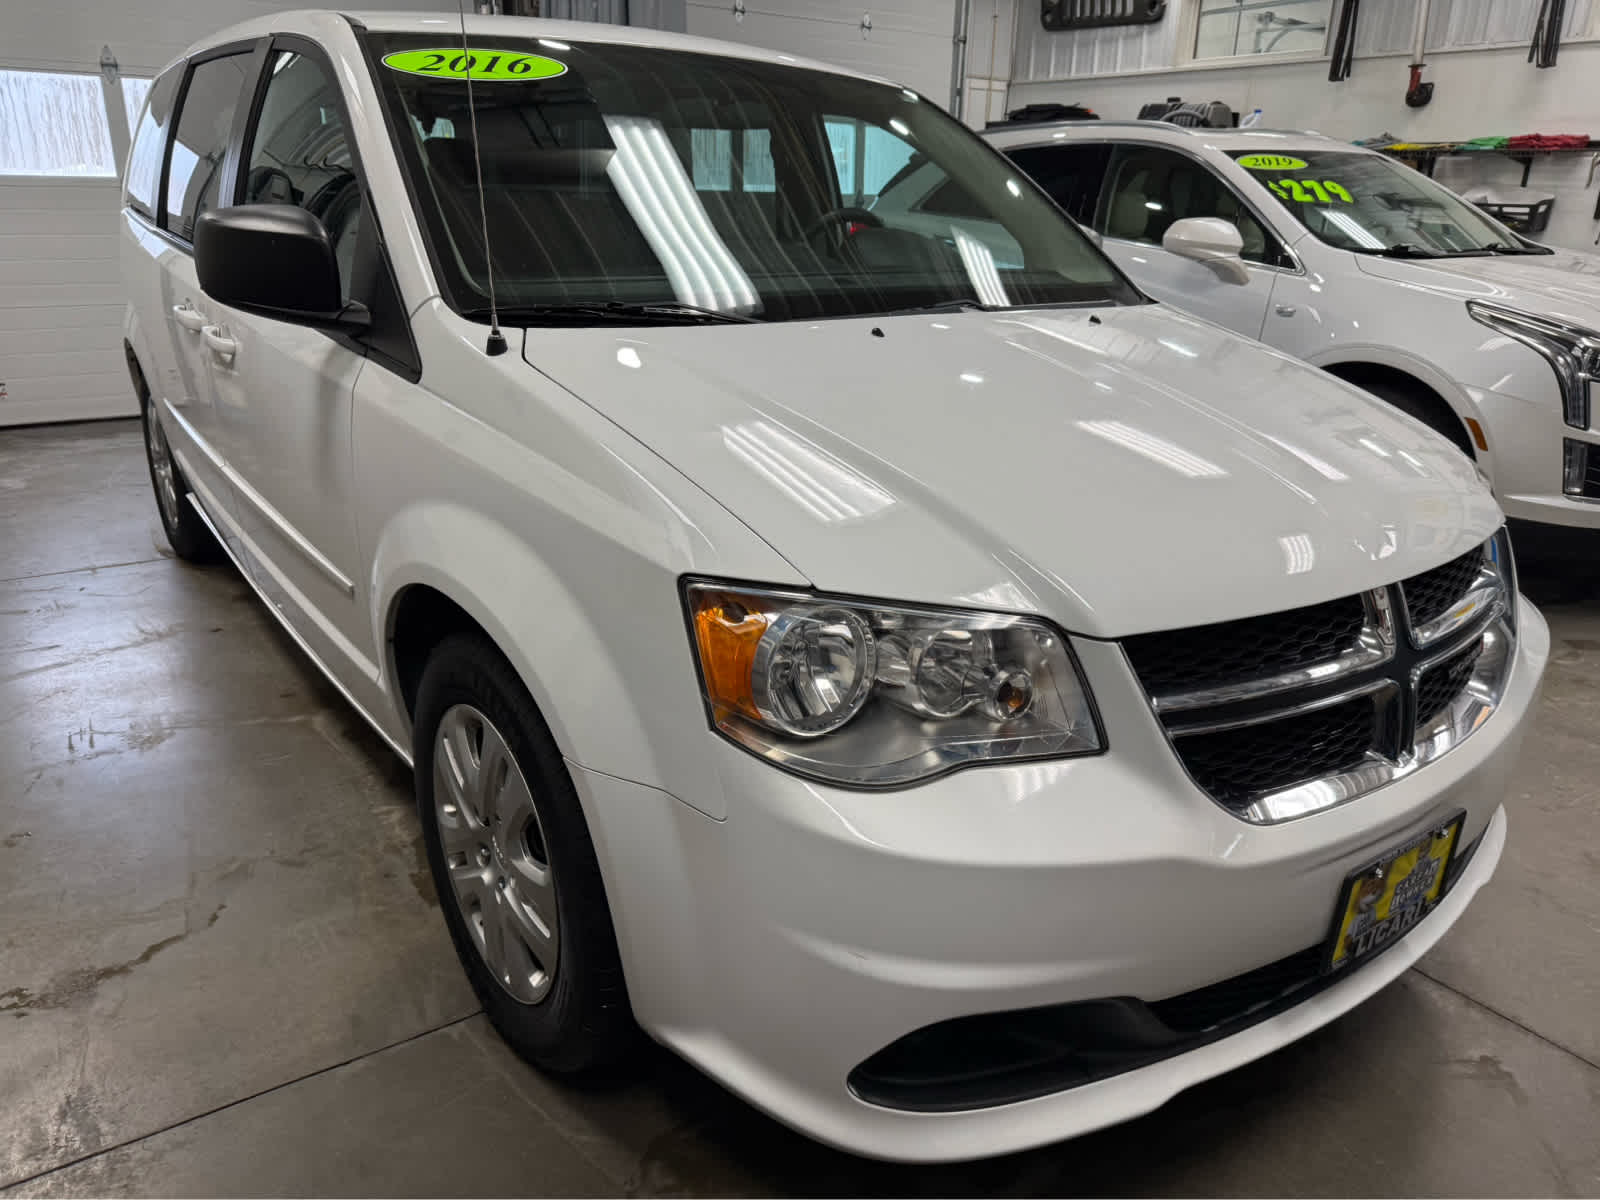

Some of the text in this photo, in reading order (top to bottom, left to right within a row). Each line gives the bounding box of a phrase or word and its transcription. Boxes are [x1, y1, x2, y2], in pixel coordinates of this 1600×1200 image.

[416, 54, 534, 74] 2016
[1253, 156, 1293, 167] 2019
[1267, 179, 1354, 203] $279
